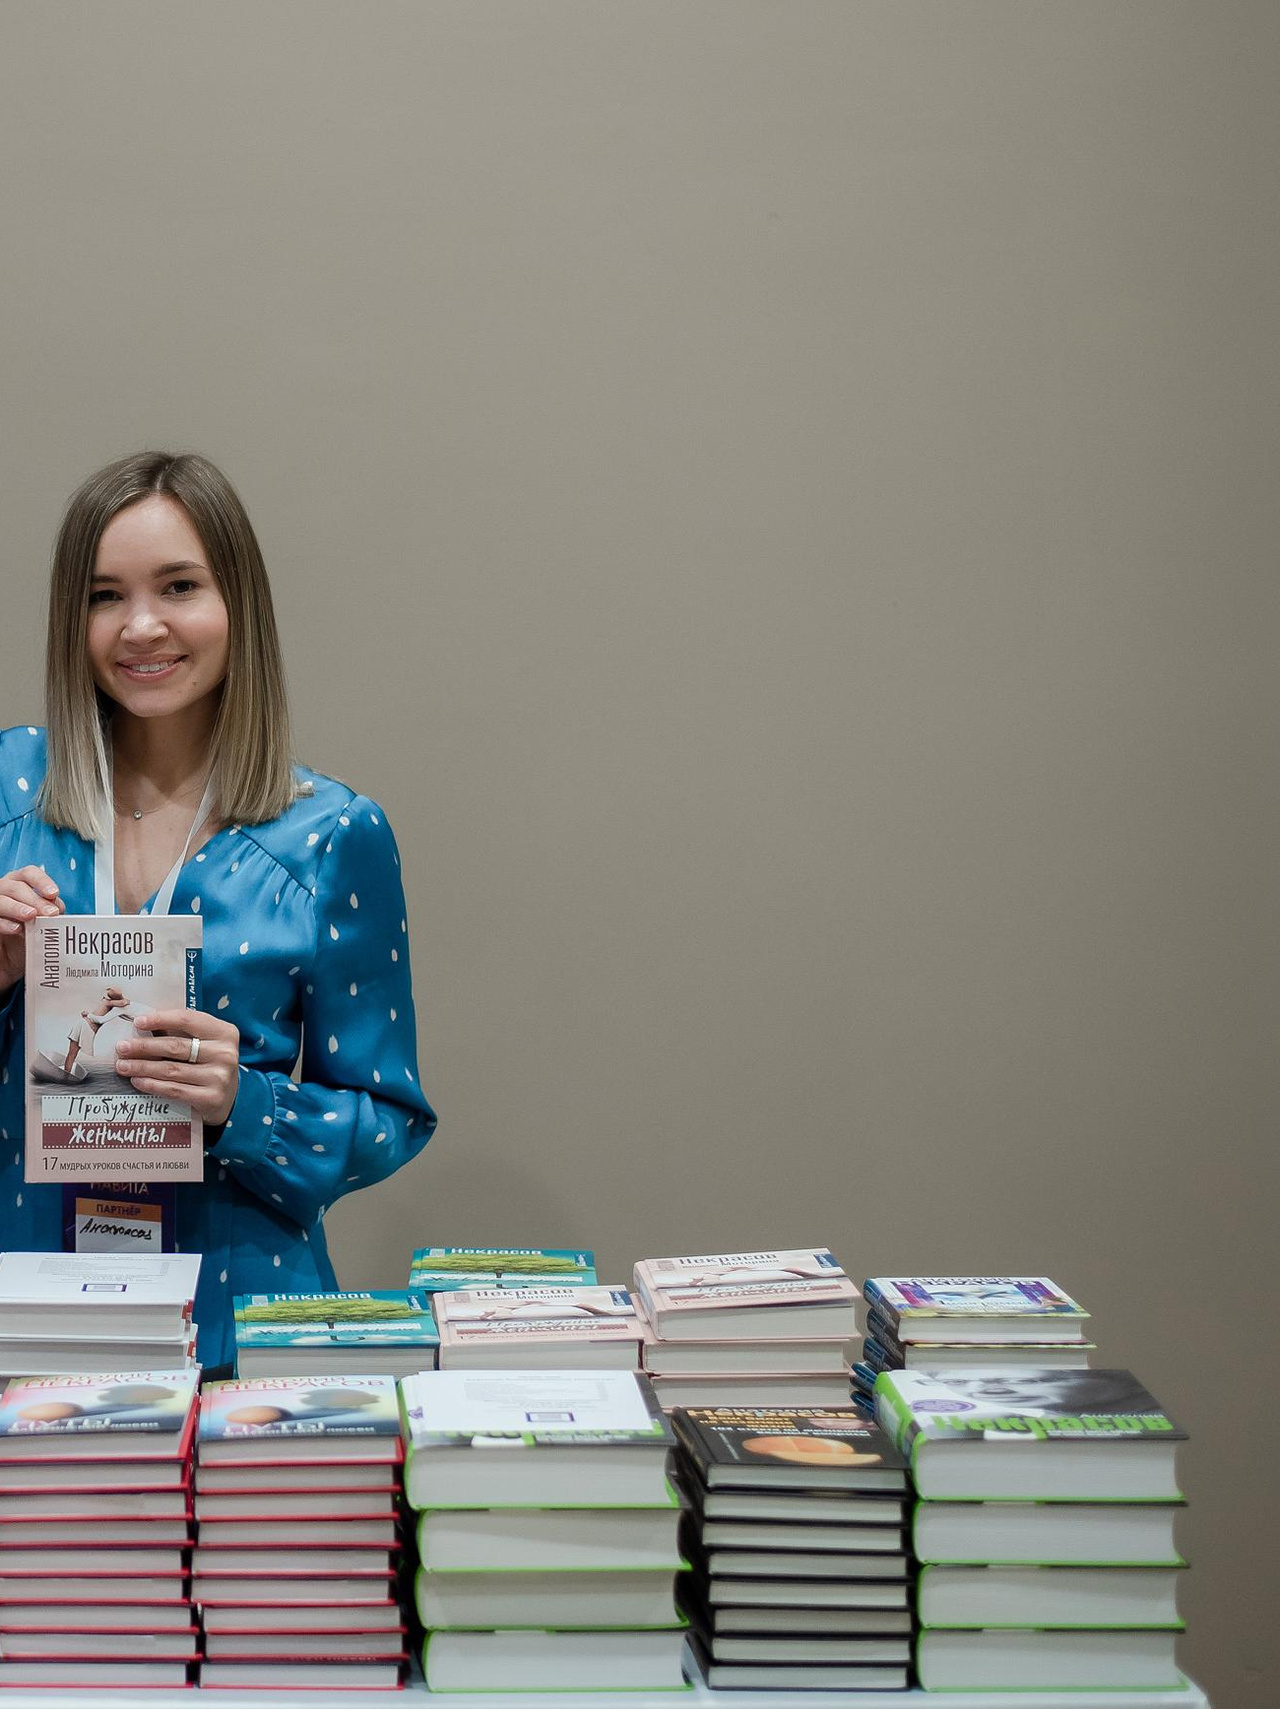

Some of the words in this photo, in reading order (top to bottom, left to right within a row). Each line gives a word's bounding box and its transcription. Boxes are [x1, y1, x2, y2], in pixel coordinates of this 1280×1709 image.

[65, 926, 154, 960] Некрасов
[40, 928, 60, 989] Анатолий
[65, 967, 99, 978] Людмила
[100, 961, 154, 980] Моторина
[68, 1096, 170, 1122] Пробуждение
[42, 1157, 58, 1171] 17
[59, 1163, 91, 1172] МУДРЫХ
[92, 1162, 121, 1170] УРОКОВ
[122, 1162, 154, 1170] СЧАСТЬЯ
[155, 1162, 161, 1170] И
[162, 1161, 190, 1170] ЛЮБВИ
[451, 1248, 542, 1256] Некрасов
[679, 1253, 777, 1265] Некрасов
[274, 1293, 372, 1301] Некрасов
[476, 1289, 574, 1300] Некрасов
[930, 1415, 1175, 1441] Некрасов
